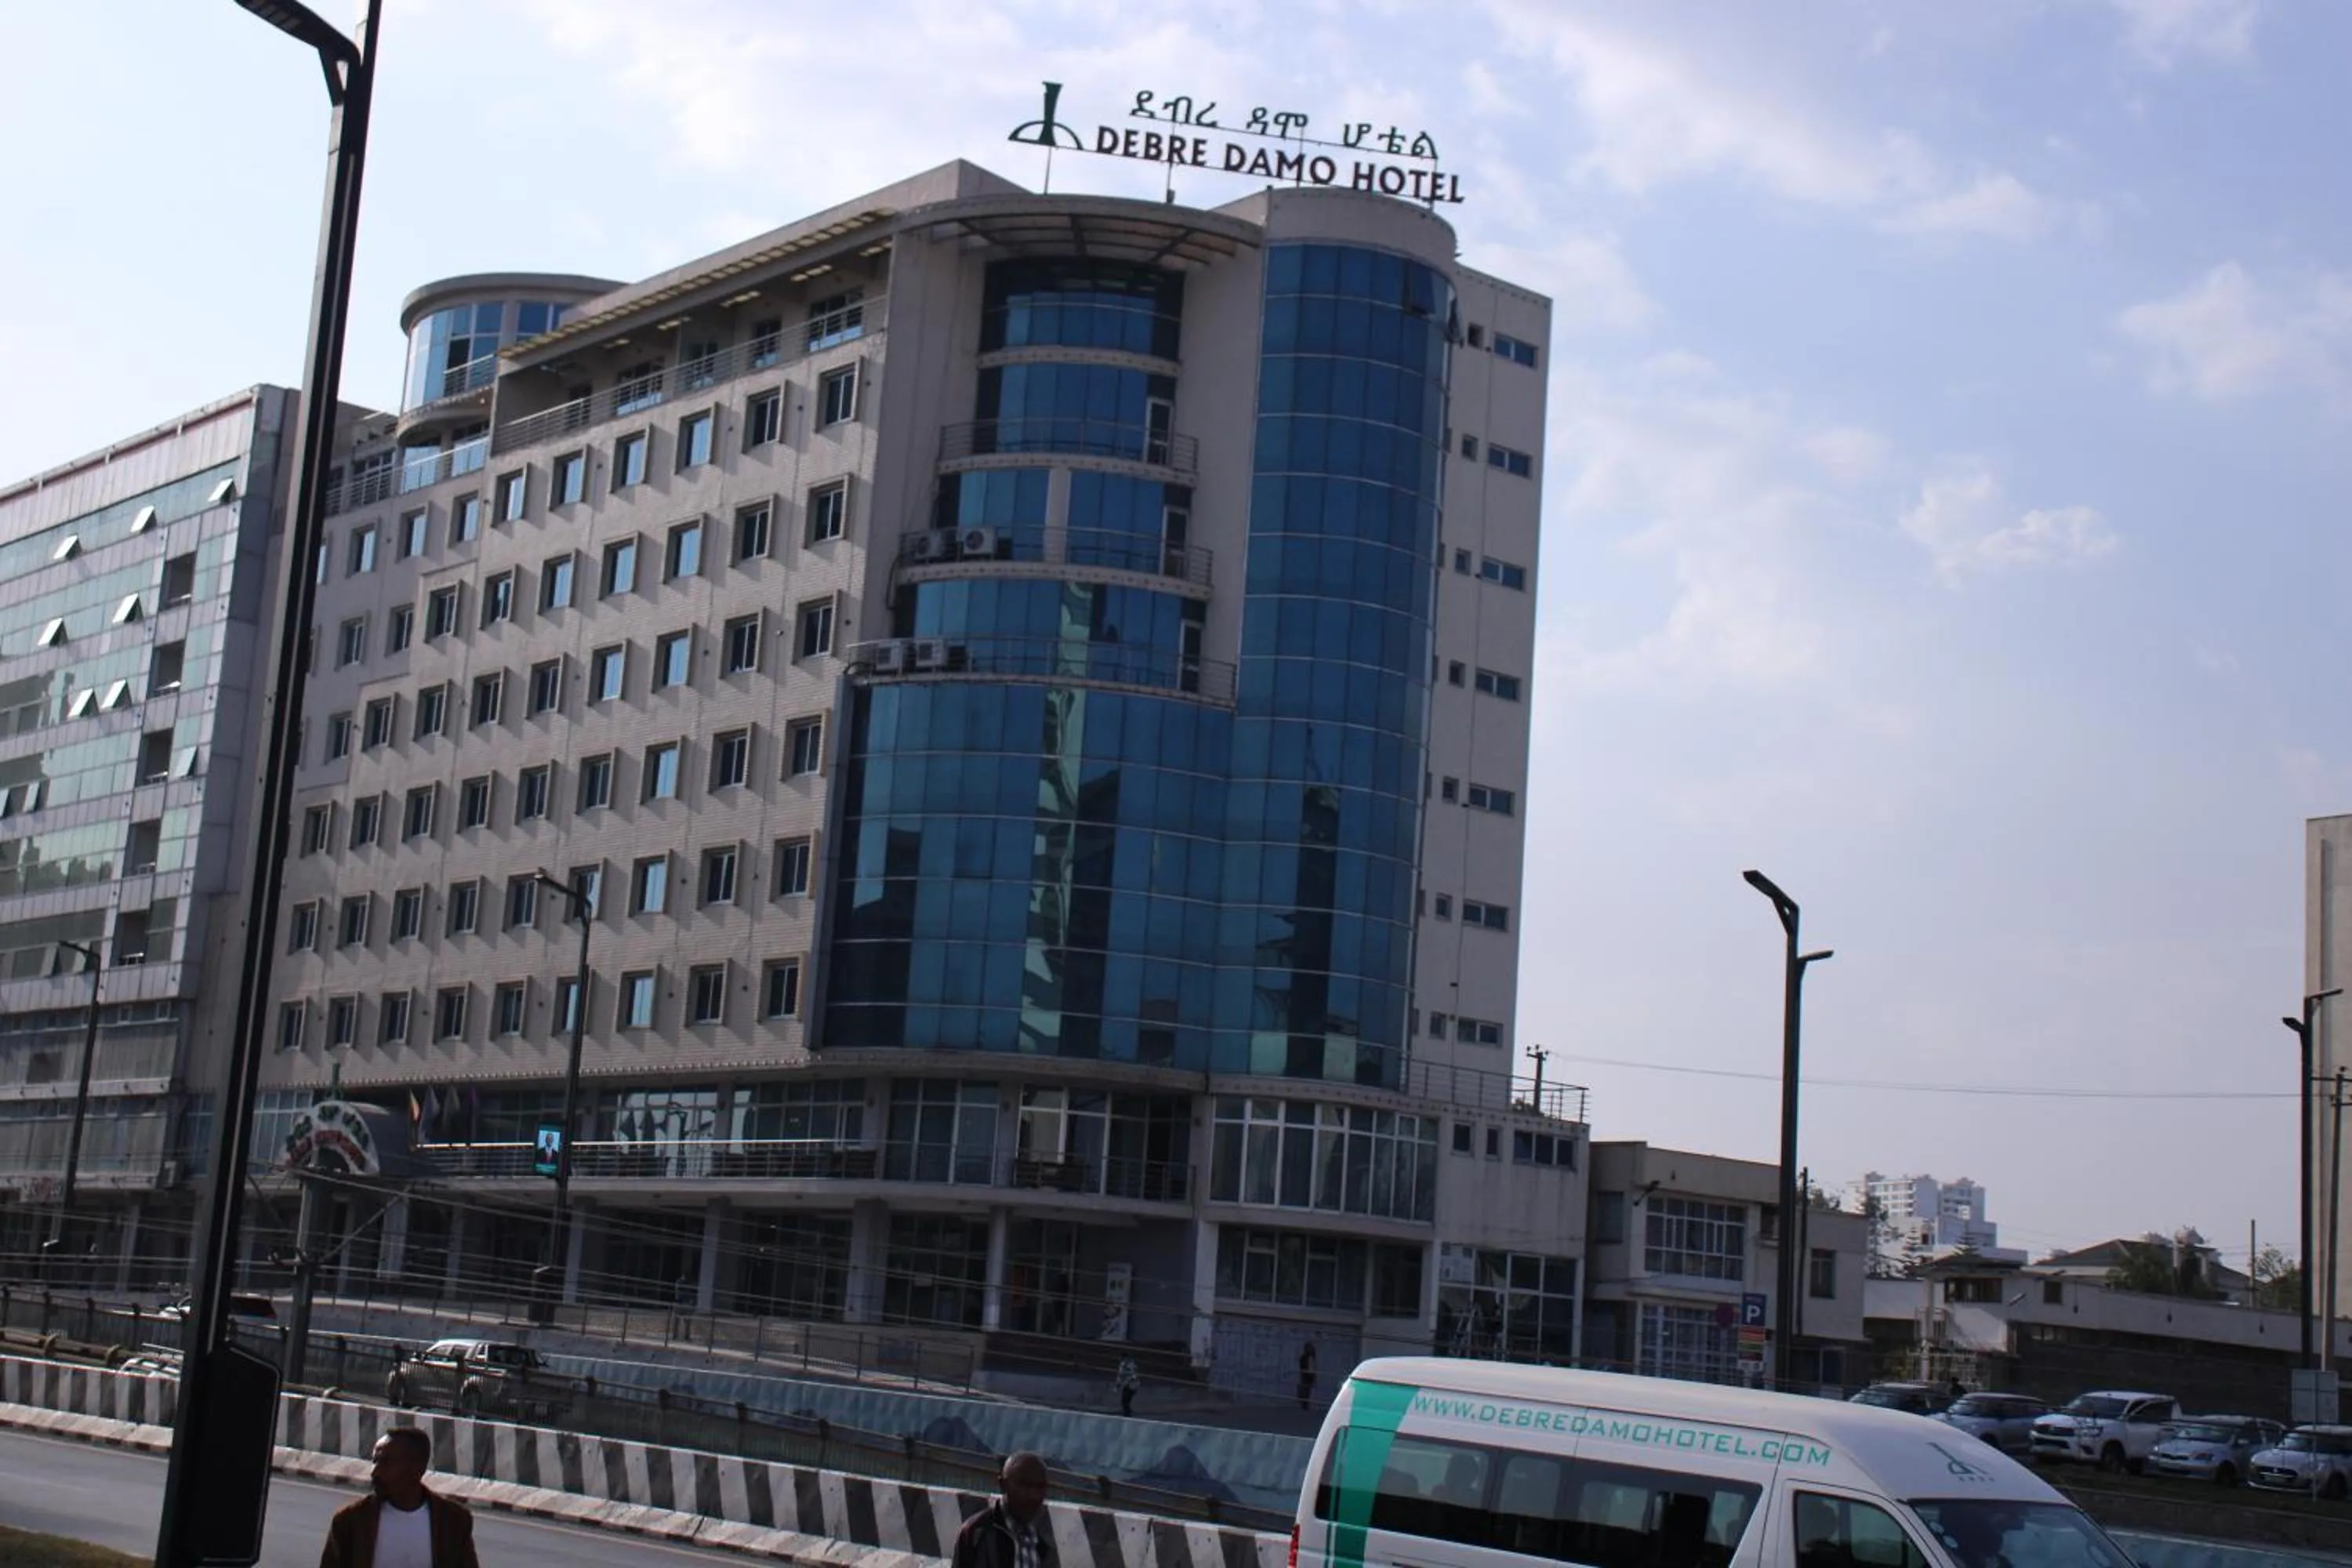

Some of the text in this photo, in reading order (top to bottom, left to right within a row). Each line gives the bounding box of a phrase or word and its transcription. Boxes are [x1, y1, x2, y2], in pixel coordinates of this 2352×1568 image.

[1129, 90, 1218, 128] ደብረ
[1343, 124, 1438, 158] ሆቴል
[1097, 125, 1465, 202] DEBRE DAMO HOTEL
[1746, 1305, 1761, 1323] P
[1413, 1395, 1831, 1466] WWW.DEBREDAMOHOTEL.COM
